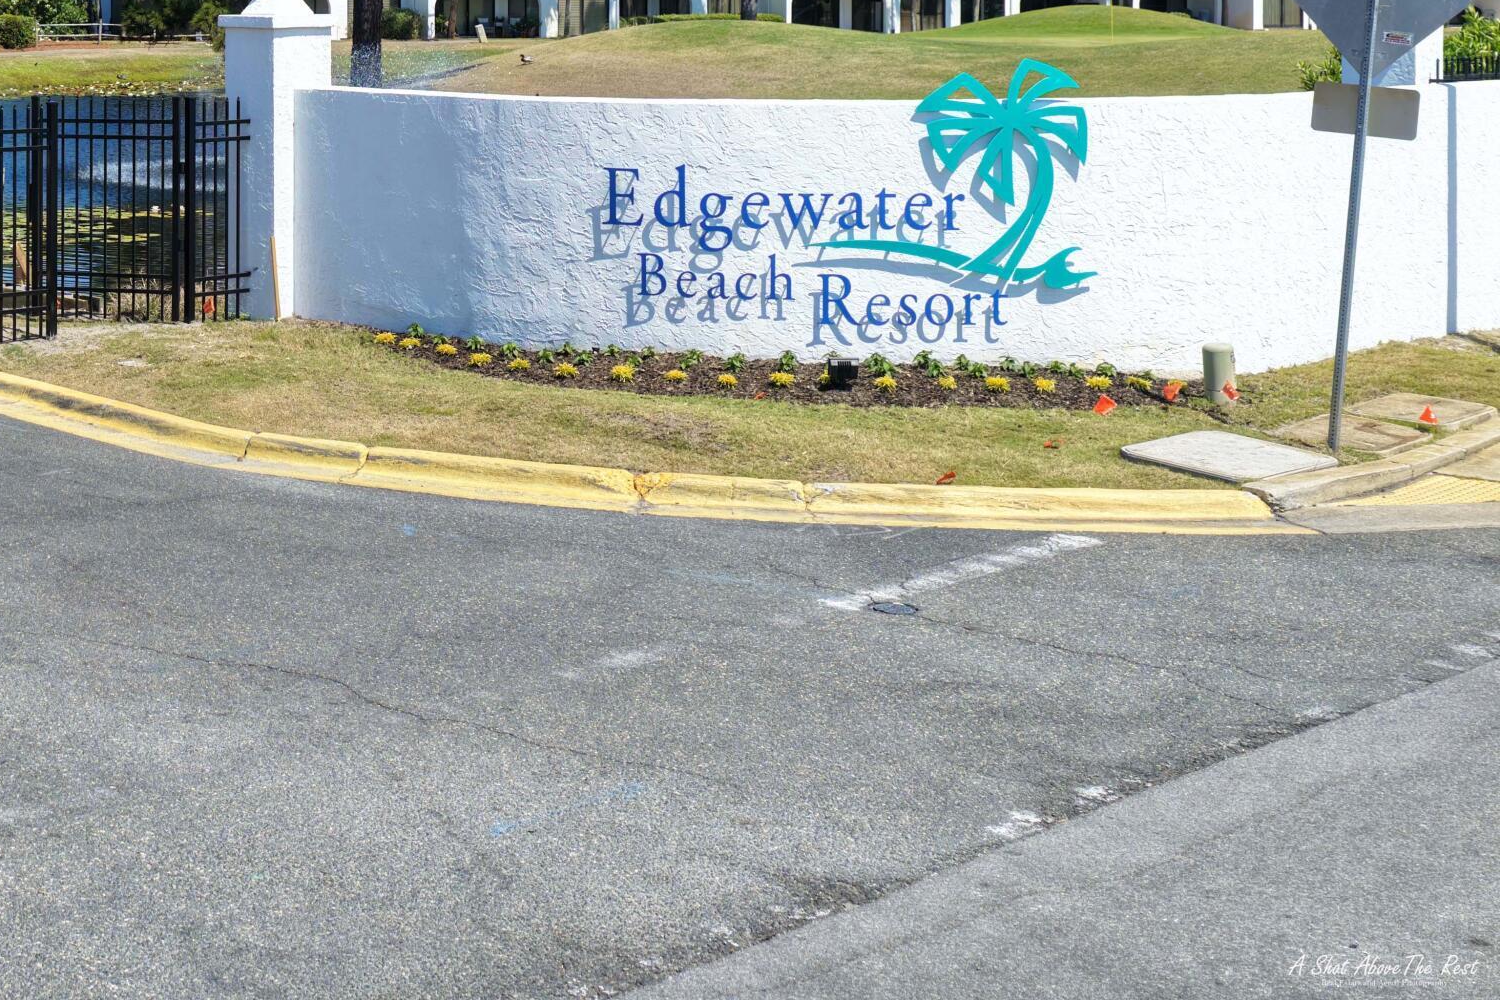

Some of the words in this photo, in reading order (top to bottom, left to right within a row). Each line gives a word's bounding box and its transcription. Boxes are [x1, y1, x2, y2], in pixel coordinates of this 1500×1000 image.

[602, 164, 966, 252] Edgewater
[637, 252, 794, 302] Beach
[817, 273, 1008, 327] Resort
